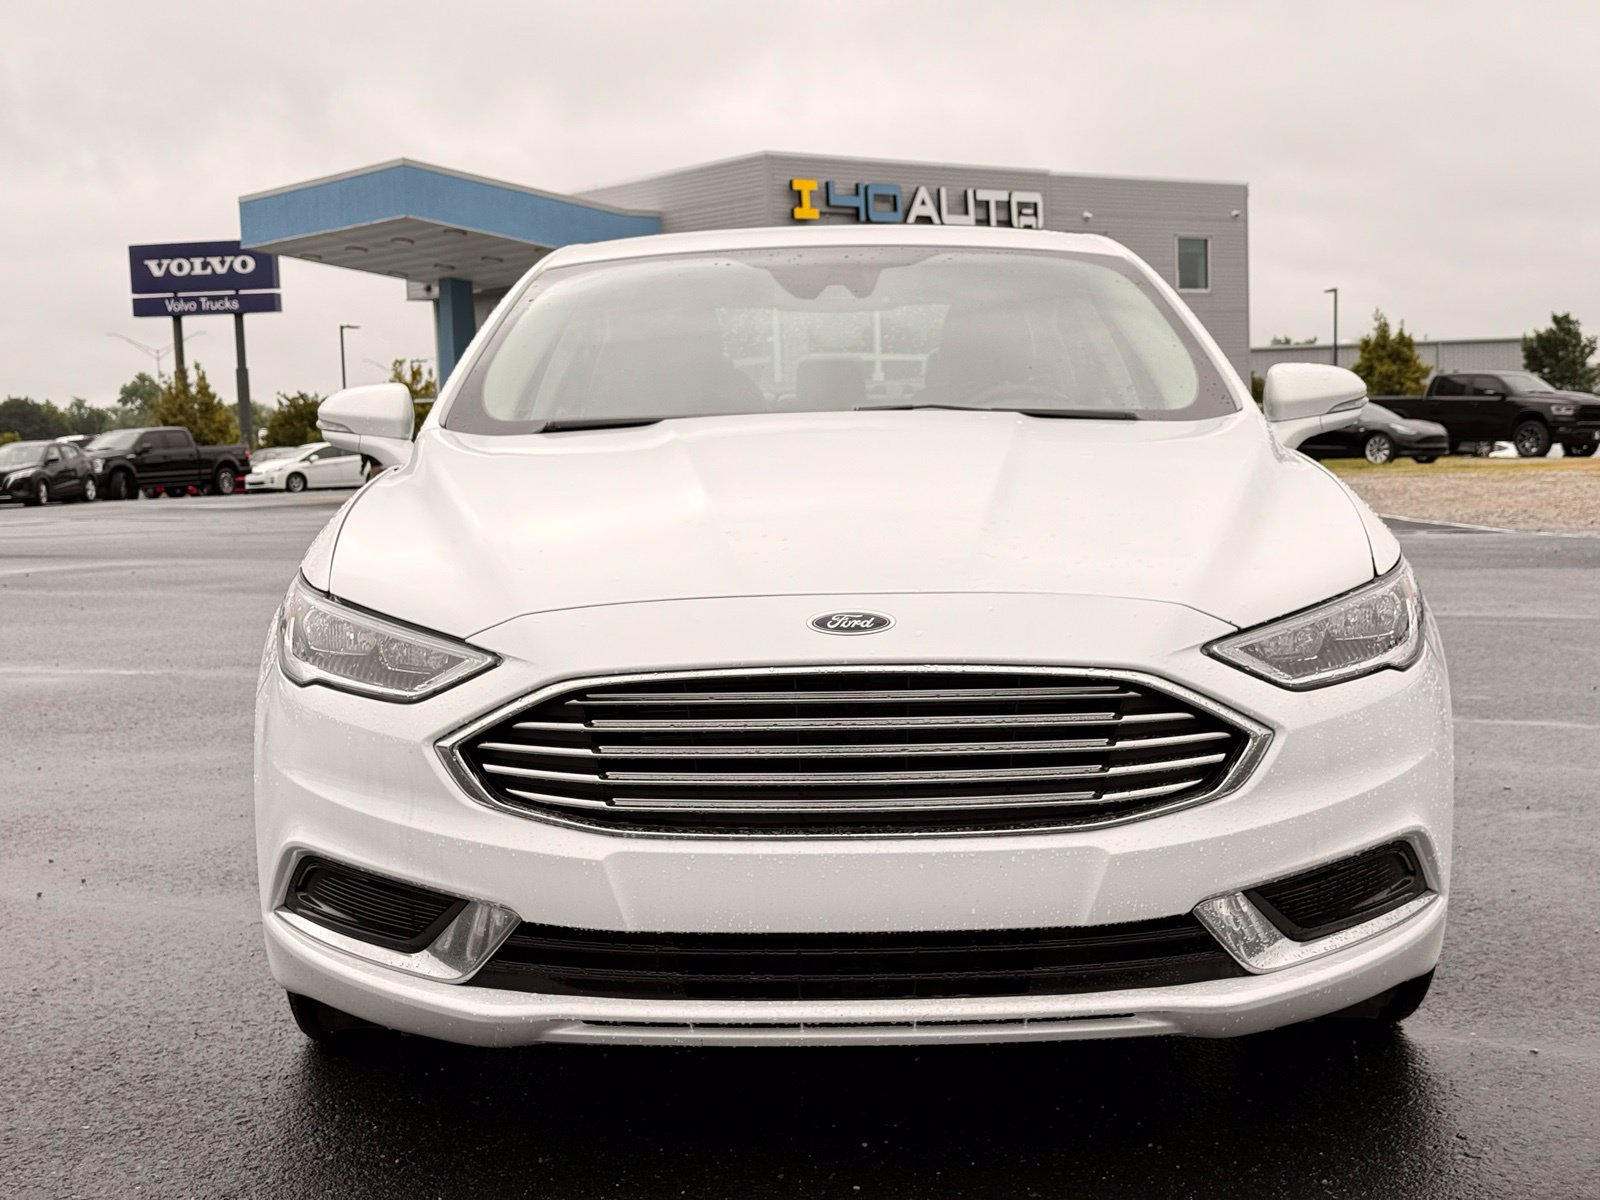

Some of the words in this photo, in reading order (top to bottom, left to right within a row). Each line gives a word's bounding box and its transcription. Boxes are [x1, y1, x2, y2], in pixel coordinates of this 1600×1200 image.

[144, 255, 256, 277] VOLVO
[165, 298, 197, 312] Volvo
[200, 296, 240, 311] Trucks
[826, 614, 875, 629] Ford
